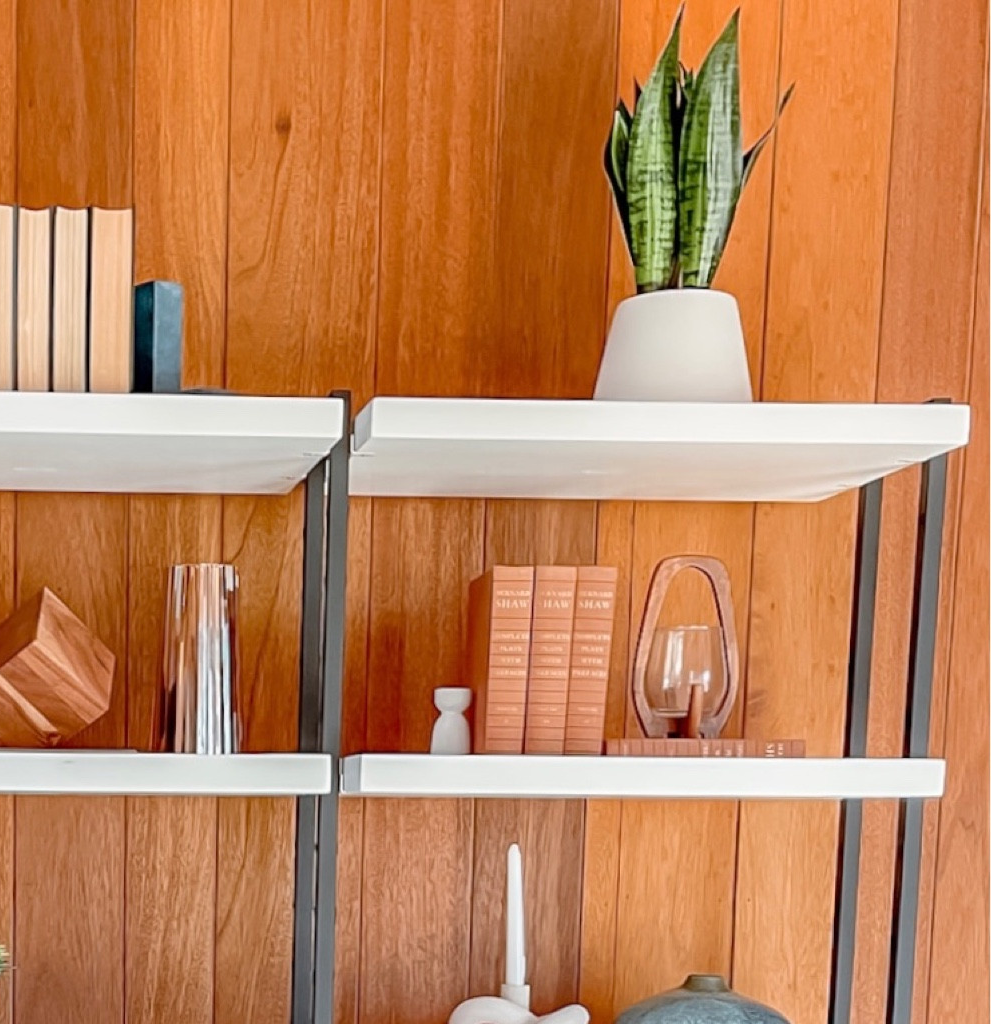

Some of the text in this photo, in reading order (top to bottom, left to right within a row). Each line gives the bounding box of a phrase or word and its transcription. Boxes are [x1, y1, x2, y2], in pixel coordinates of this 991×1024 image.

[496, 598, 528, 609] SHAW
[539, 599, 569, 609] HAW
[579, 599, 611, 609] SHAW
